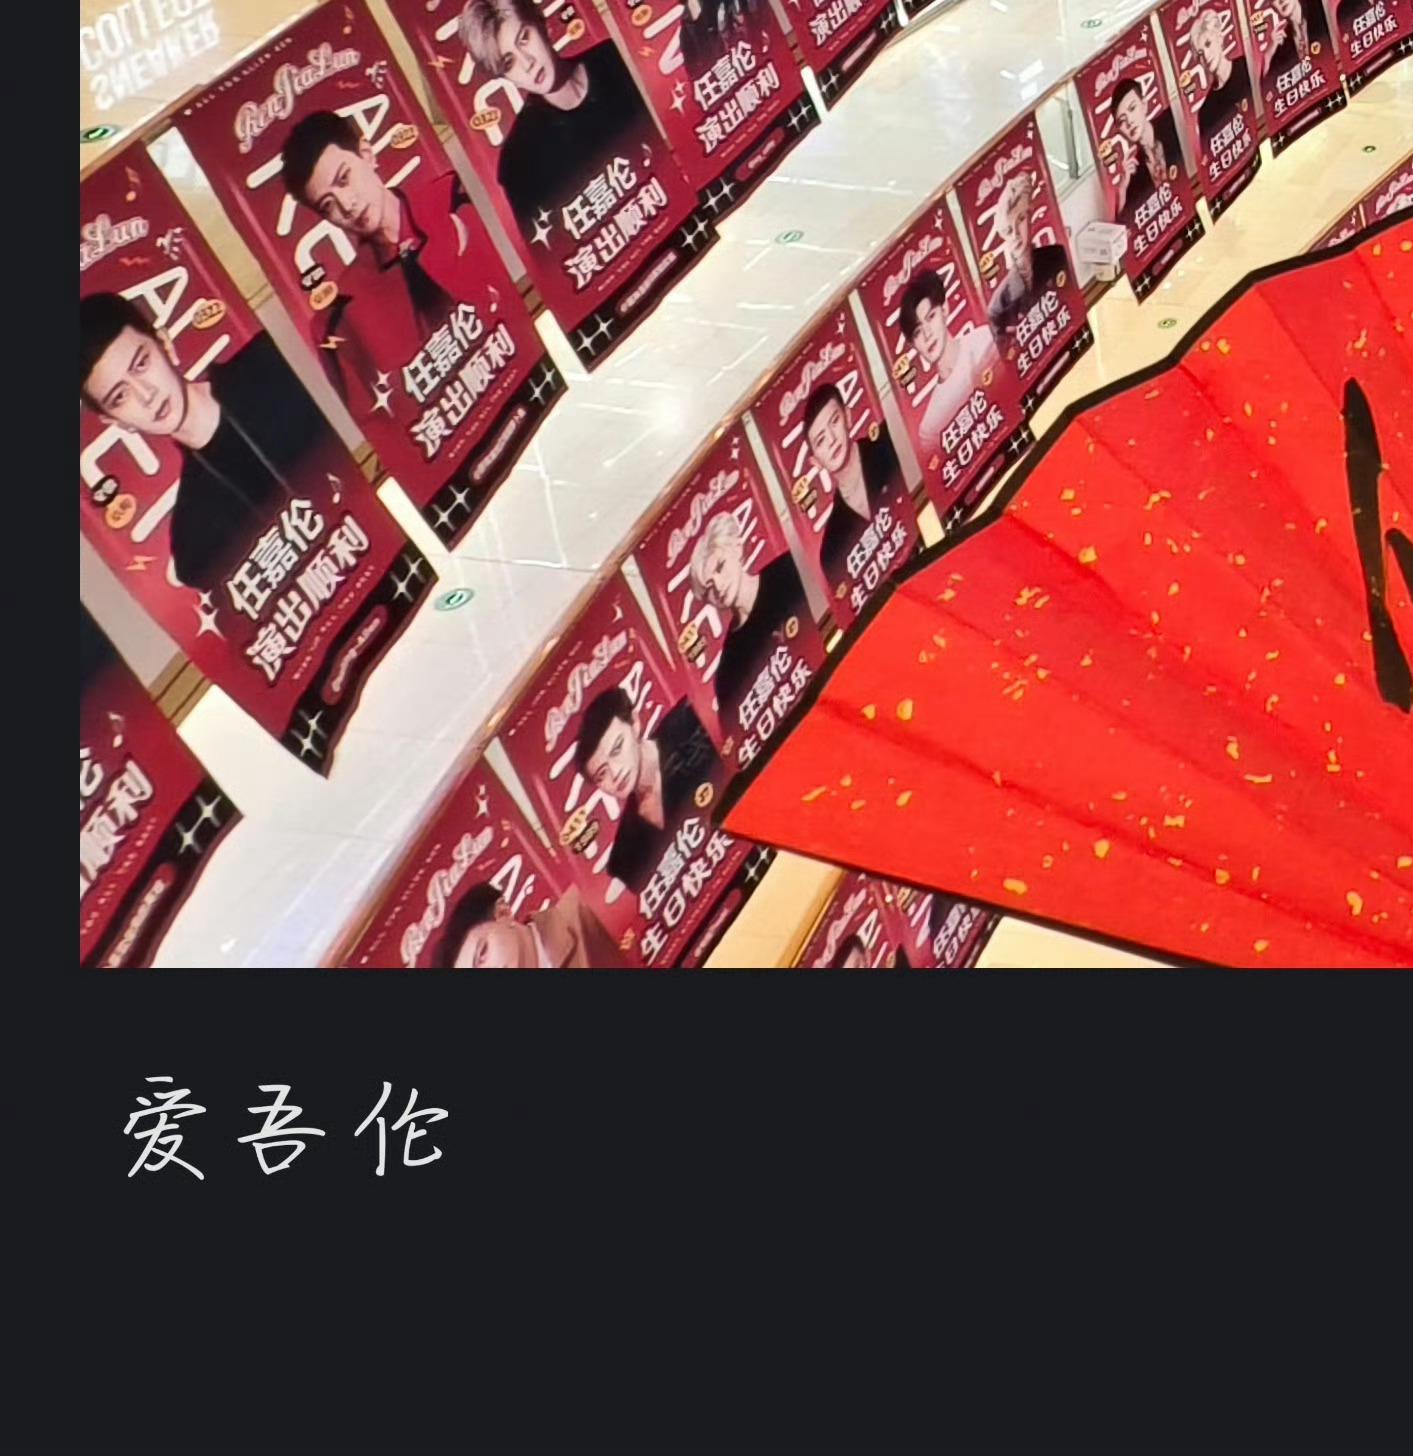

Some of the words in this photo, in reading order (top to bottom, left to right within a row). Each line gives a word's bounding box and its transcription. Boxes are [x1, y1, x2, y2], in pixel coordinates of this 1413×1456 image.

[693, 40, 757, 112] 任嘉伦
[696, 63, 782, 153] 演出顺利
[402, 303, 485, 404] 任嘉伦
[1015, 288, 1060, 346] 任嘉伦
[1016, 305, 1072, 378] 生日快乐
[408, 324, 517, 458] 演出顺利
[227, 496, 326, 620] 任嘉伦
[245, 514, 370, 684] 演出顺利
[737, 644, 793, 729] 任嘉伦
[737, 657, 814, 772] 生日快乐
